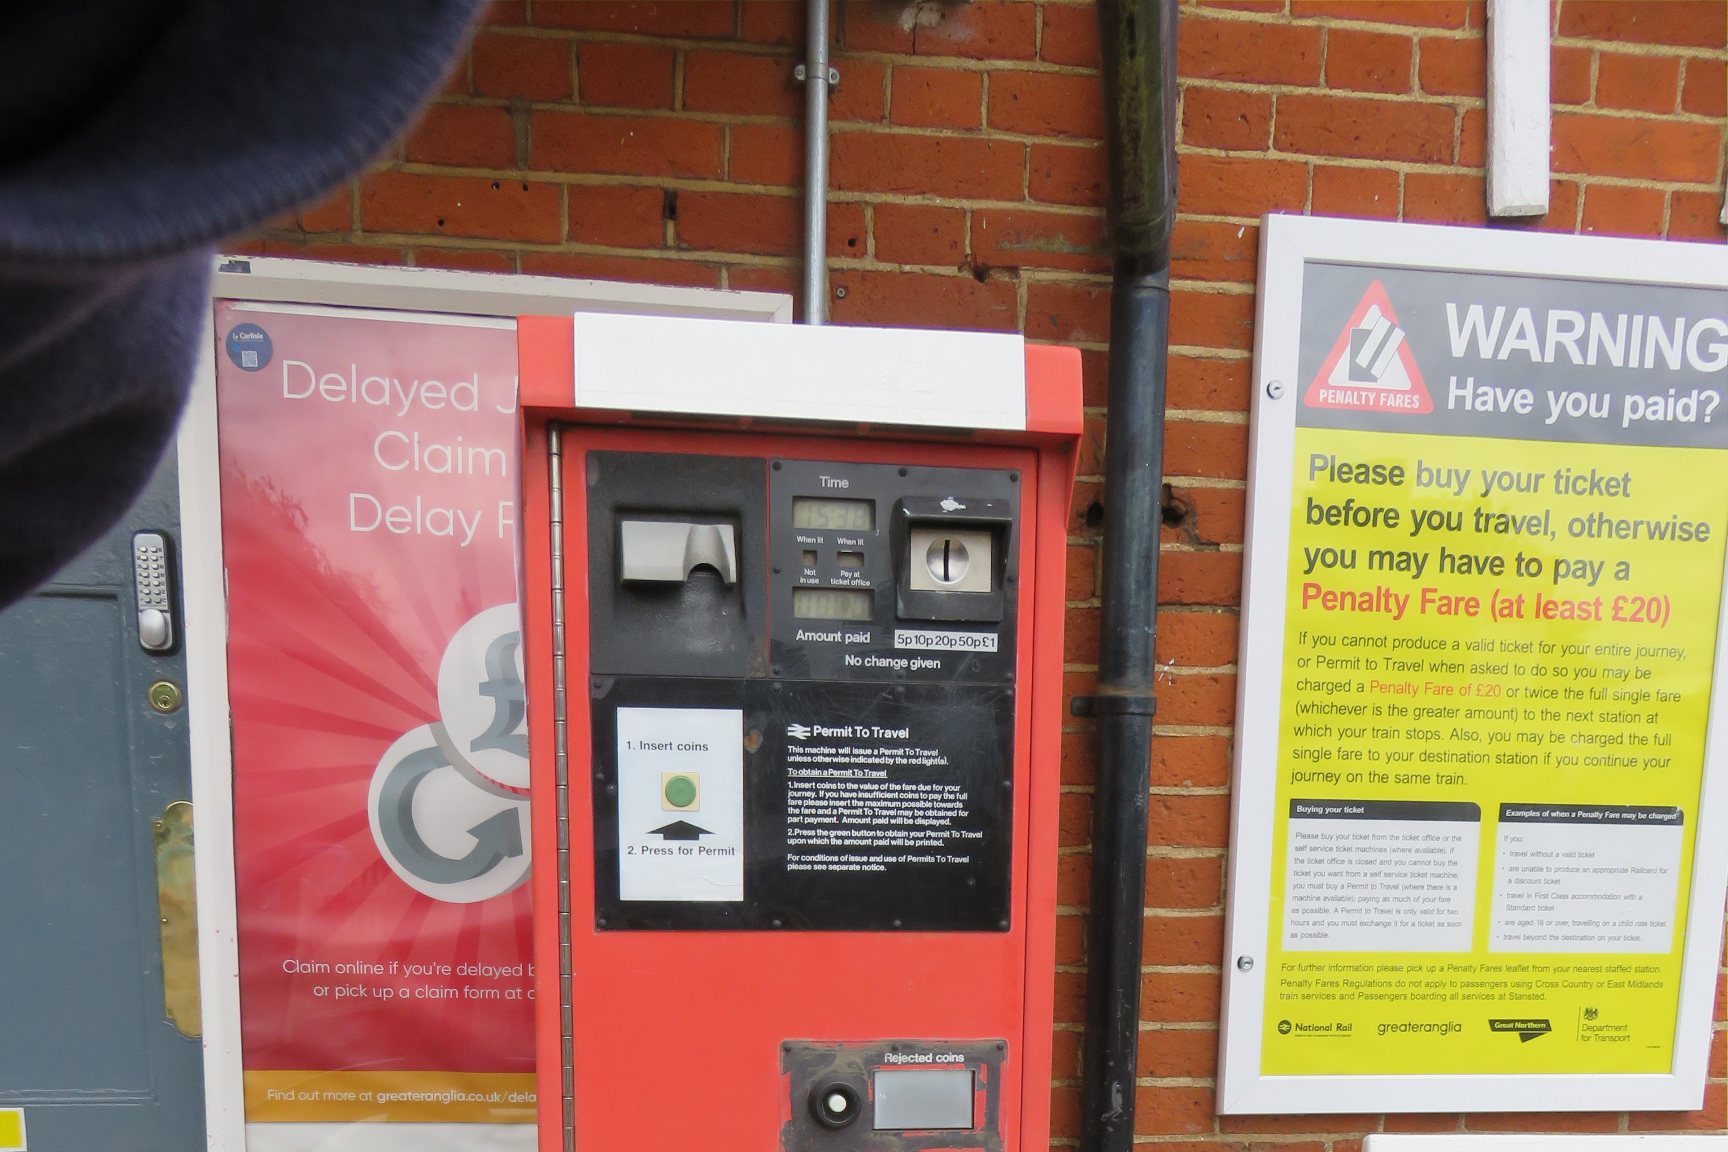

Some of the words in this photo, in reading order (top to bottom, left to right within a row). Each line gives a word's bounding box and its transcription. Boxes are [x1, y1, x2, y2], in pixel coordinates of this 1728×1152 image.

[1445, 303, 1728, 373] WARNING
[284, 360, 478, 416] Delayed
[1320, 390, 1376, 406] PENALTY
[1379, 392, 1420, 409] FARES
[1448, 376, 1534, 414] Have
[1545, 388, 1609, 425] you
[1622, 388, 1720, 428] paid?
[374, 431, 506, 476] Claim
[820, 475, 849, 489] Time
[1309, 454, 1404, 486] Please
[1417, 460, 1470, 496] buy
[1480, 468, 1545, 497] your
[1554, 468, 1631, 497] ticket
[350, 493, 481, 546] Delay
[1306, 498, 1399, 529] before
[1410, 509, 1463, 536] you
[1474, 507, 1556, 542] travel,
[1567, 513, 1710, 542] otherwise
[797, 536, 816, 544] When
[1303, 547, 1357, 574] you
[1368, 552, 1427, 578] may
[1439, 547, 1505, 575] have
[1516, 552, 1542, 577] to
[1553, 557, 1604, 586] pay
[1614, 560, 1630, 581] a
[851, 579, 870, 587] office
[1302, 582, 1410, 621] Penalty
[1421, 587, 1480, 617] Fare
[1491, 588, 1526, 623] (at
[1535, 588, 1602, 622] least
[1611, 595, 1670, 627] £20)
[796, 629, 842, 643] Amount
[845, 631, 871, 645] paid
[897, 634, 912, 646] 5p
[914, 635, 933, 647] 10p
[935, 636, 957, 648] 20p
[959, 636, 981, 648] 50p
[983, 637, 995, 647] £1
[1298, 631, 1307, 644] If
[1311, 635, 1336, 648] you
[1341, 636, 1387, 647] cannot
[1391, 636, 1447, 650] produce
[1451, 640, 1460, 650] a
[1464, 639, 1495, 651] valid
[1499, 640, 1533, 653] ticket
[1538, 640, 1556, 654] for
[1560, 644, 1590, 657] your
[1594, 645, 1631, 656] entire
[1634, 647, 1685, 661] journey,
[845, 656, 862, 668] No
[864, 656, 908, 670] change
[910, 657, 941, 670] given
[1296, 657, 1312, 668] or
[1316, 655, 1361, 669] Permit
[1365, 657, 1378, 670] to
[1382, 657, 1424, 672] Travel
[1428, 660, 1465, 673] when
[1469, 662, 1509, 675] asked
[1513, 663, 1526, 675] to
[1530, 663, 1548, 676] do
[1552, 666, 1569, 677] so
[1573, 667, 1597, 680] you
[1601, 668, 1631, 682] may
[1634, 666, 1652, 679] be
[1296, 678, 1351, 695] charged
[1356, 682, 1365, 692] a
[1369, 680, 1419, 697] Penalty
[1424, 681, 1454, 695] Fare
[1458, 683, 1472, 696] of
[1476, 684, 1501, 697] £20
[1506, 687, 1520, 698] or
[1524, 686, 1559, 699] twice
[1563, 687, 1584, 700] the
[1589, 687, 1608, 700] full
[1612, 689, 1651, 704] single
[1655, 689, 1681, 702] fare
[814, 725, 852, 737] Permit
[854, 726, 869, 738] To
[871, 727, 909, 738] Travel
[626, 741, 636, 750] 1.
[640, 741, 674, 751] Insert
[677, 742, 709, 752] coins
[787, 745, 804, 753] This
[915, 748, 938, 756] Travel
[885, 756, 895, 765] by
[921, 757, 949, 766] light(s).
[799, 768, 821, 776] obtain
[1296, 805, 1324, 814] Buying
[627, 846, 637, 855] 2.
[641, 845, 674, 856] Press
[678, 845, 696, 856] for
[699, 845, 736, 857] Permit
[283, 959, 330, 974] Claim
[336, 961, 384, 975] online
[389, 961, 399, 975] if
[402, 961, 451, 978] you're
[457, 963, 523, 979] delayed
[314, 986, 330, 997] or
[335, 984, 367, 999] pick
[373, 988, 394, 1000] up
[399, 988, 410, 999] a
[415, 986, 459, 999] claim
[464, 986, 500, 1000] form
[505, 987, 522, 1000] at
[1295, 1023, 1332, 1032] National
[1337, 1023, 1352, 1032] Rail
[1378, 1022, 1462, 1035] greateranglia
[1582, 1024, 1628, 1032] Department
[1581, 1034, 1591, 1042] for
[1594, 1034, 1630, 1043] Transport
[884, 1053, 933, 1064] Rejected
[935, 1053, 965, 1063] coins
[268, 1089, 294, 1101] Find
[298, 1091, 320, 1101] out
[323, 1092, 356, 1101] more
[360, 1092, 373, 1101] at
